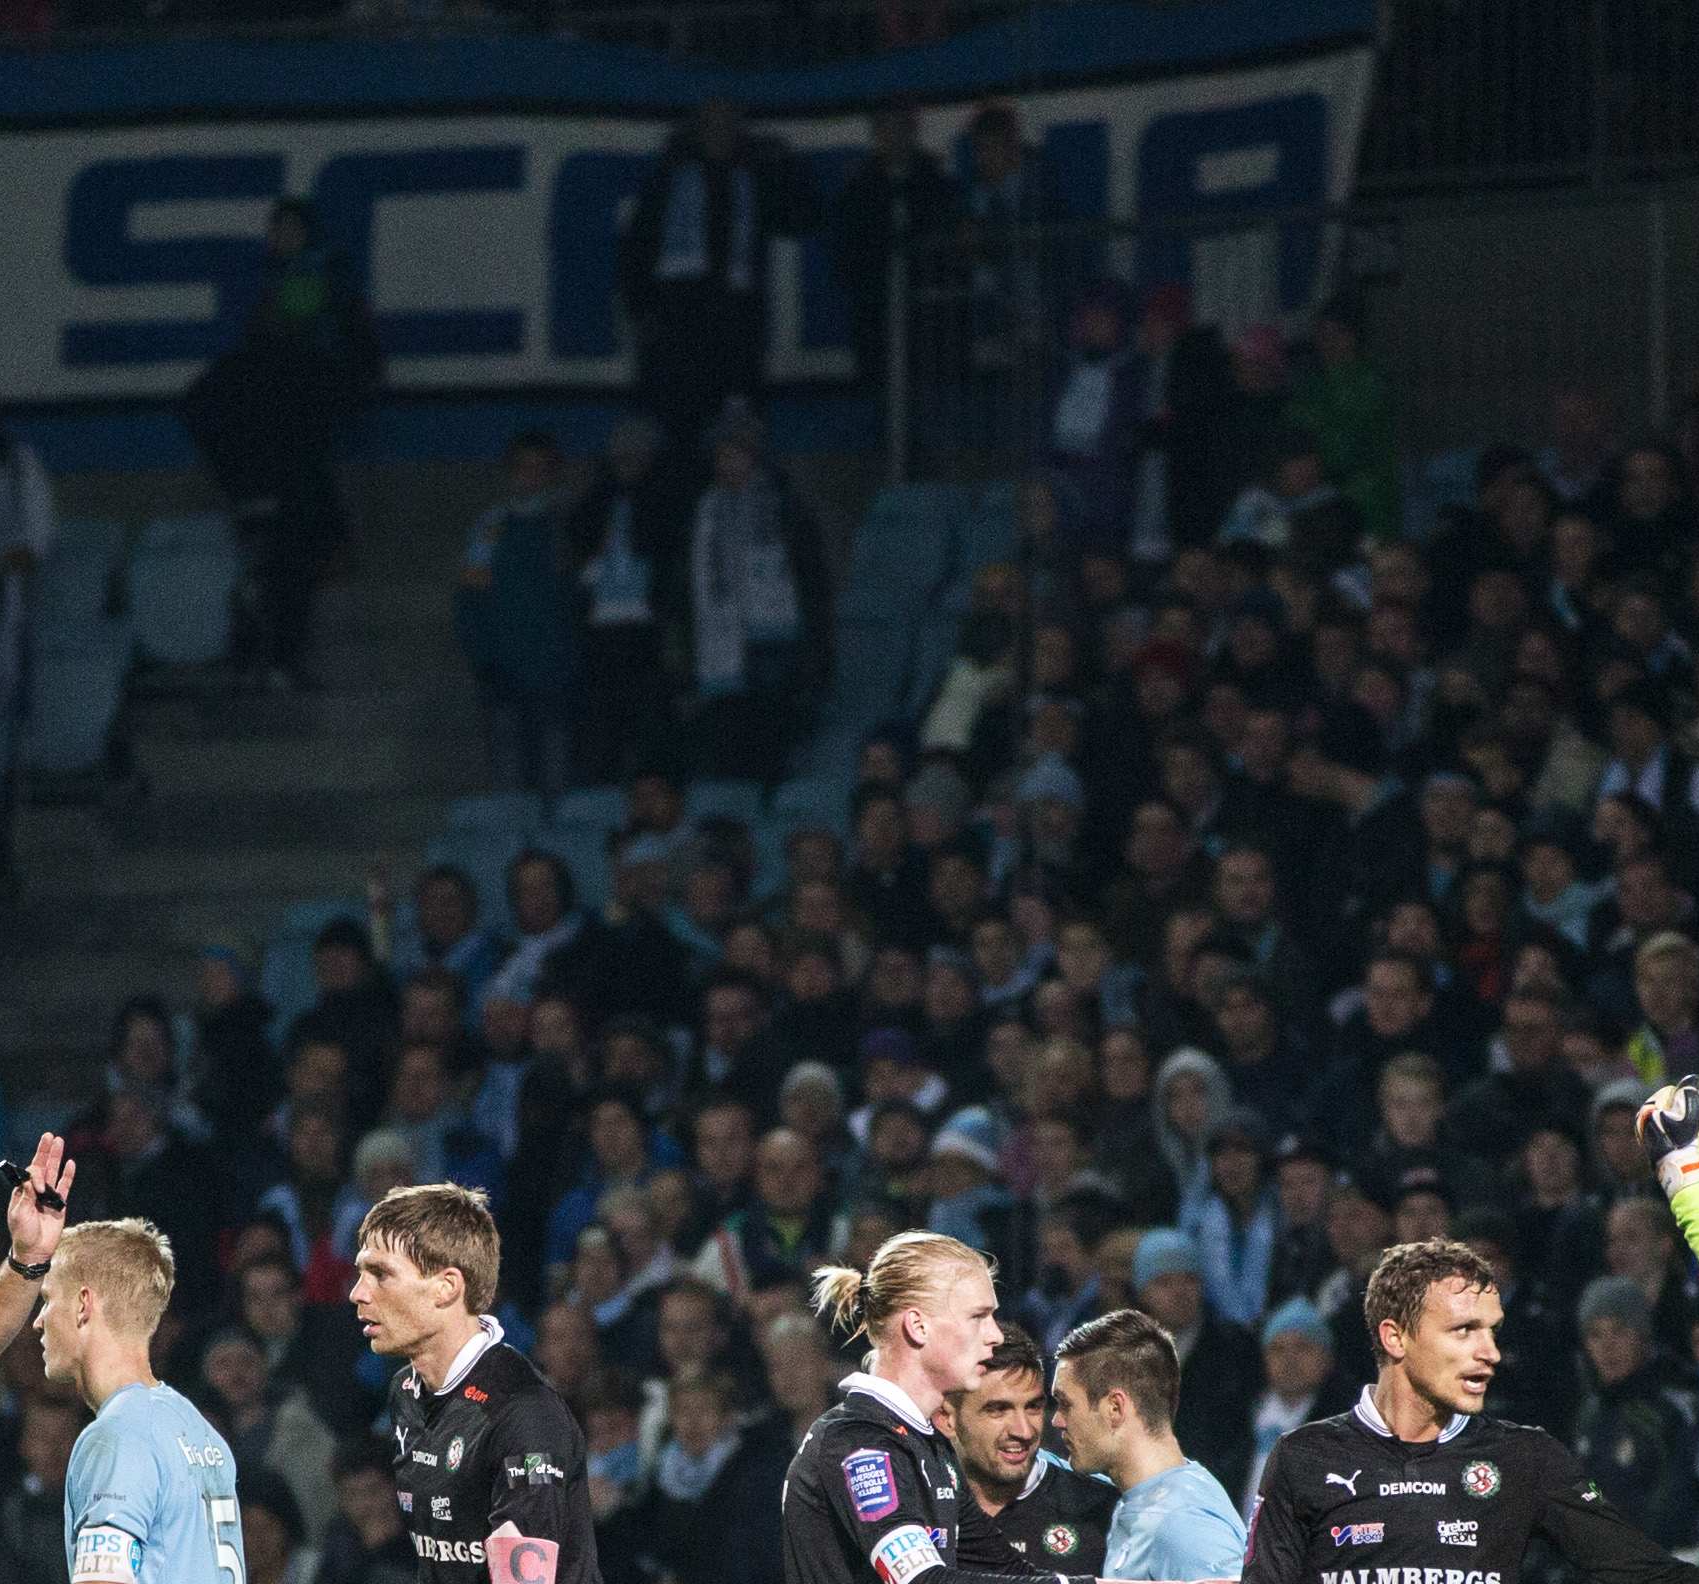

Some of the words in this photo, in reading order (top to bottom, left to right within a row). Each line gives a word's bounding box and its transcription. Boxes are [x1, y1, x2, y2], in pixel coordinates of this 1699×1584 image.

[1379, 1481, 1447, 1497] DEMCOM
[74, 1534, 122, 1554] TIPS
[881, 1531, 933, 1562] TIPS
